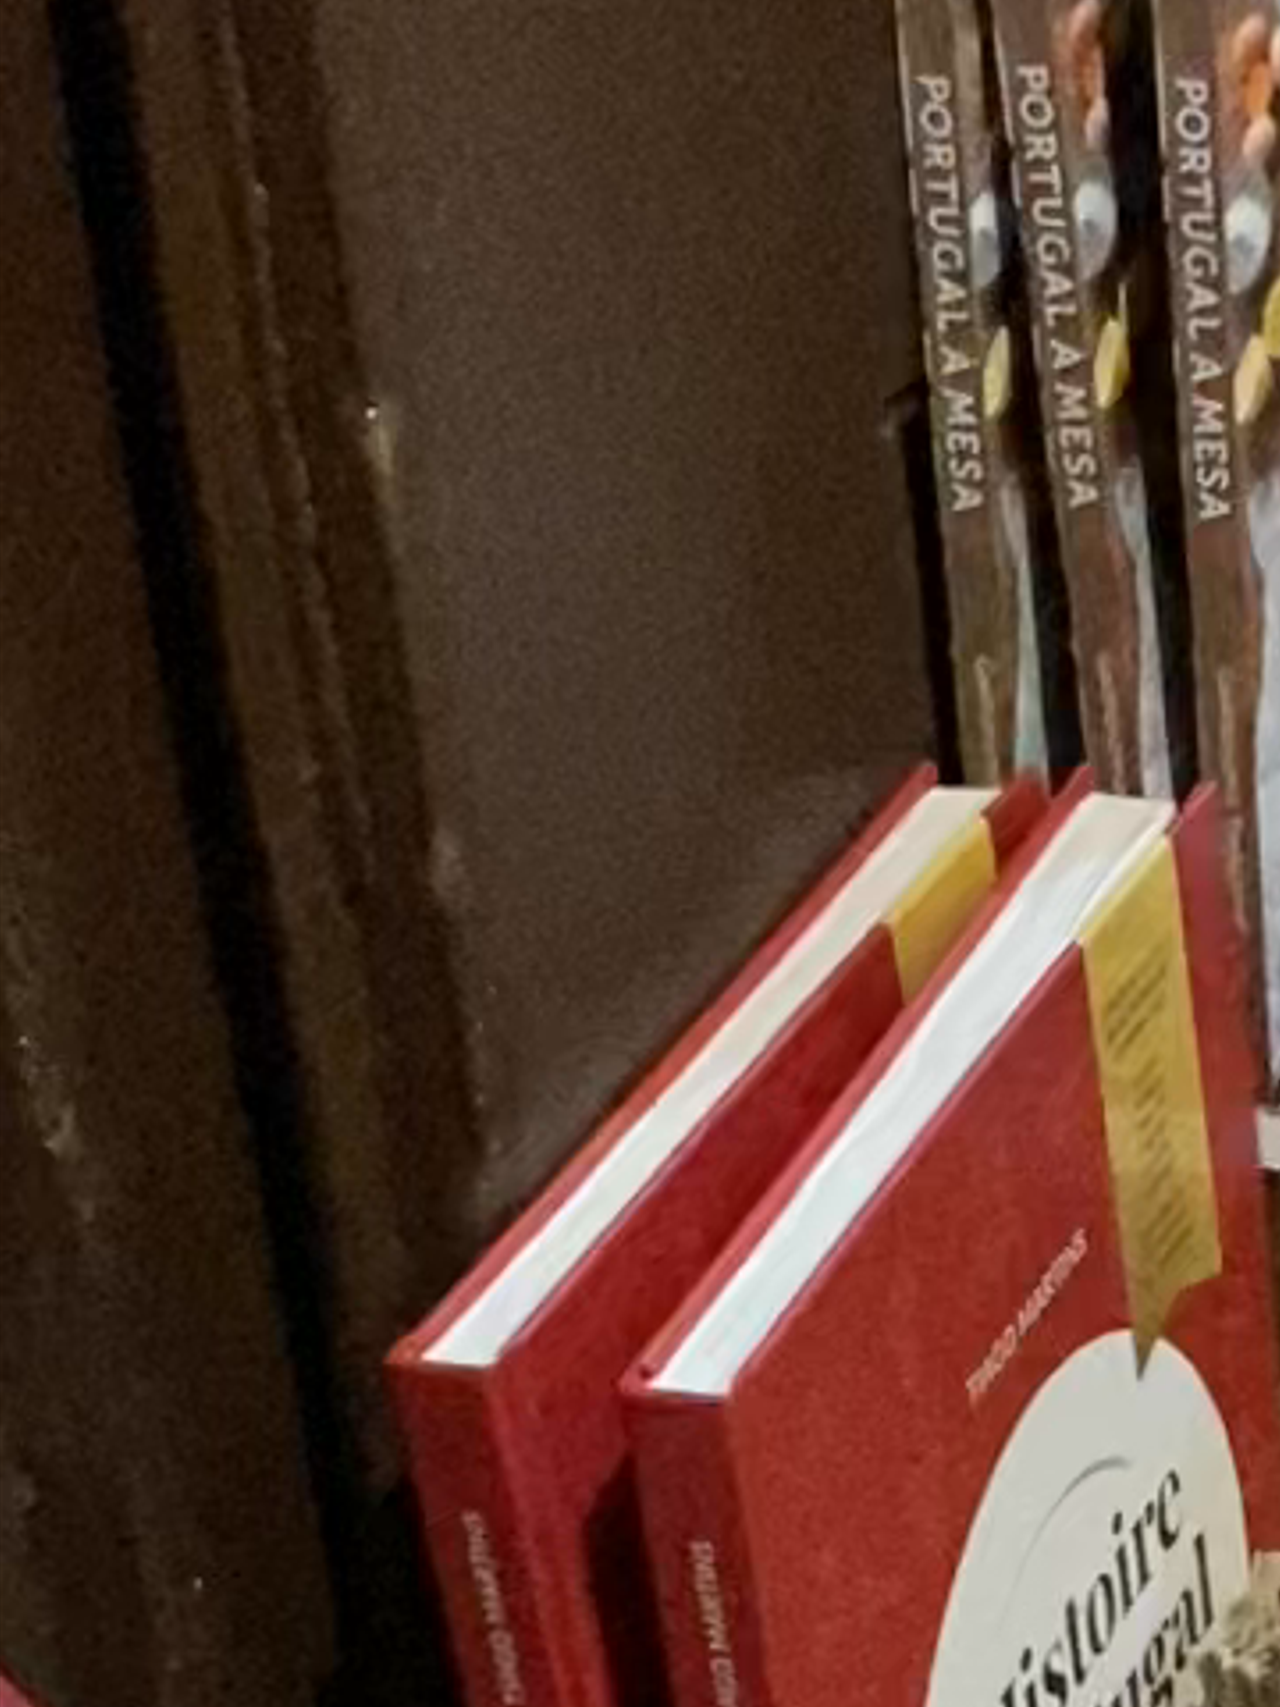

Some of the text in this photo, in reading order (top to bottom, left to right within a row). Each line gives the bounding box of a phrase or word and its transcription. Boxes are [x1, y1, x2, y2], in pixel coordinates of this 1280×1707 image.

[914, 72, 971, 334] PORTUGAL
[1016, 63, 1078, 326] PORTUGAL
[1055, 381, 1099, 509] MESA
[1174, 75, 1222, 341] PORTUGAL
[940, 387, 985, 512] MESA
[1190, 393, 1232, 522] MESA
